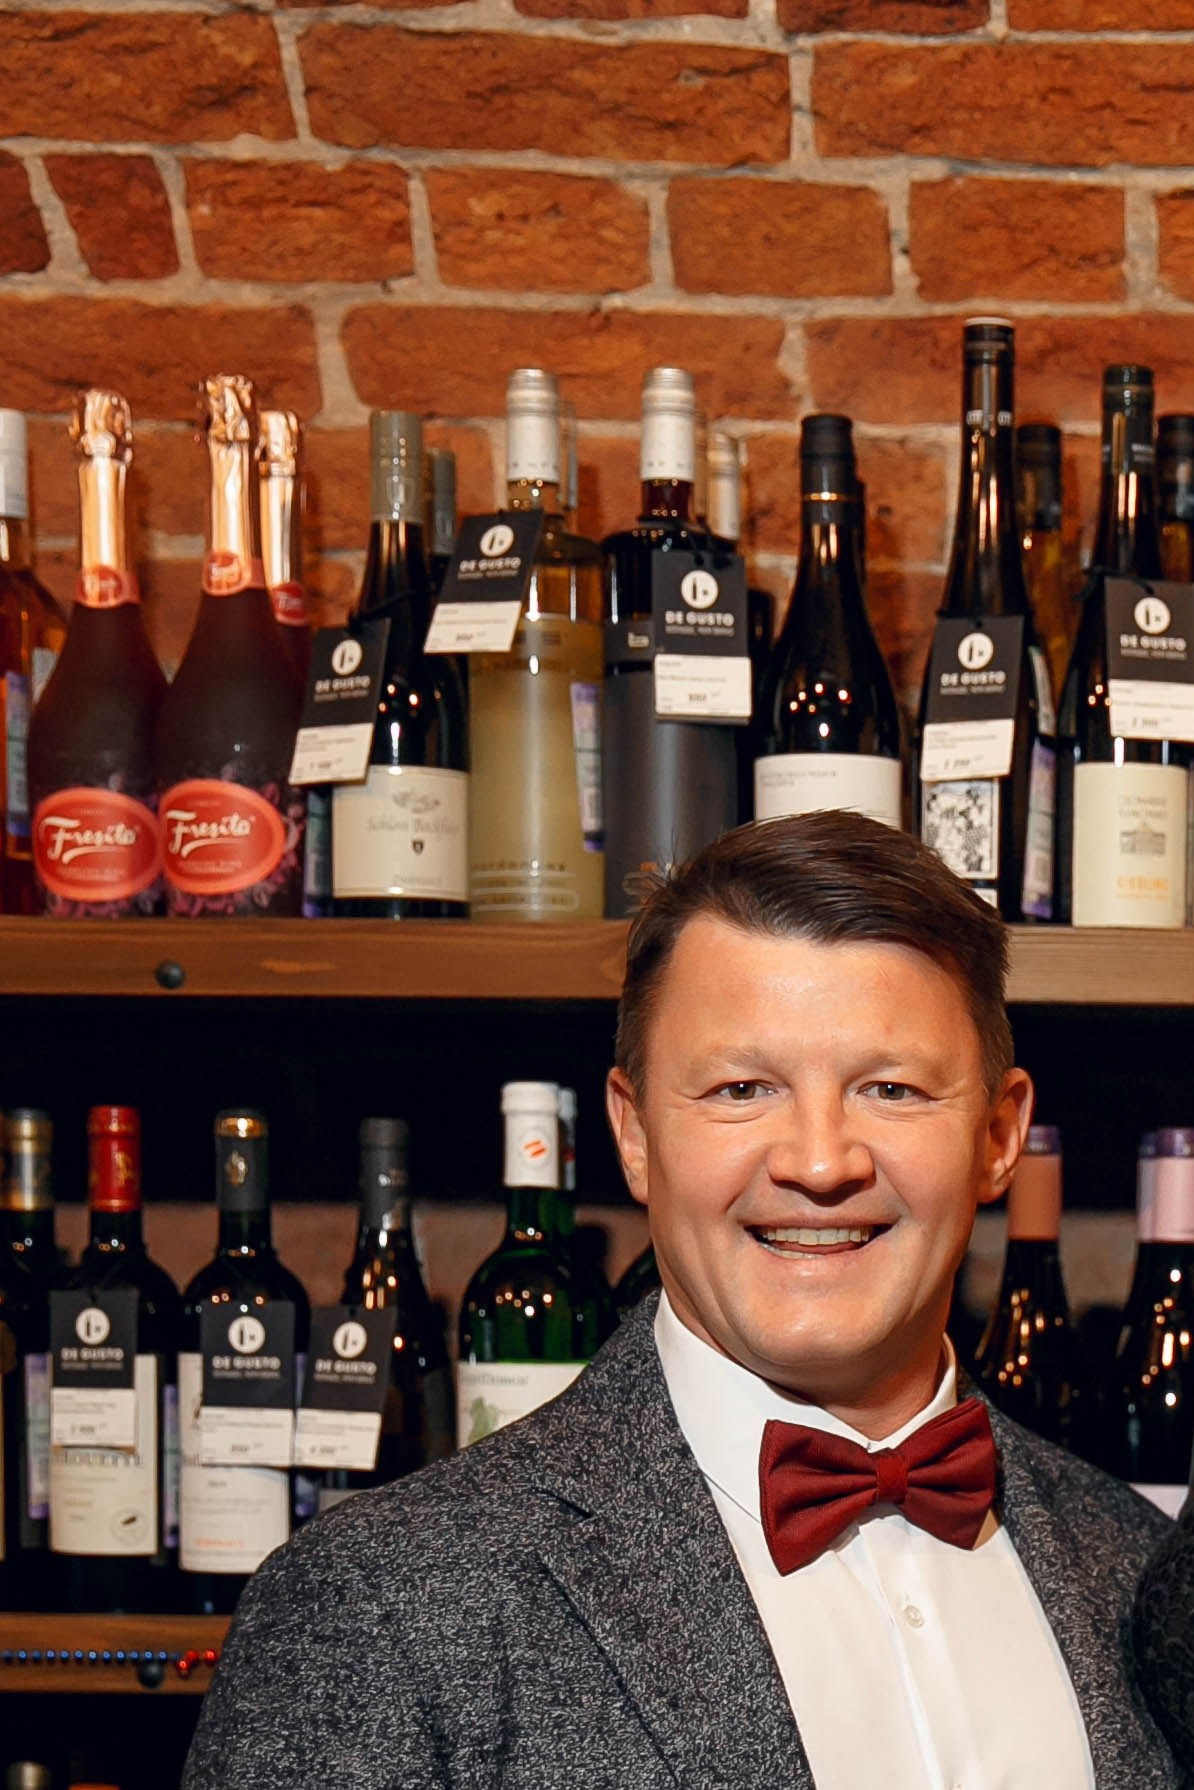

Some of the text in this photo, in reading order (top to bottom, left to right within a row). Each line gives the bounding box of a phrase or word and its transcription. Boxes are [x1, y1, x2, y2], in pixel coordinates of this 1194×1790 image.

[42, 815, 137, 863] Fresita
[165, 809, 252, 858] Fresita
[212, 1355, 281, 1370] DE GUSTO
